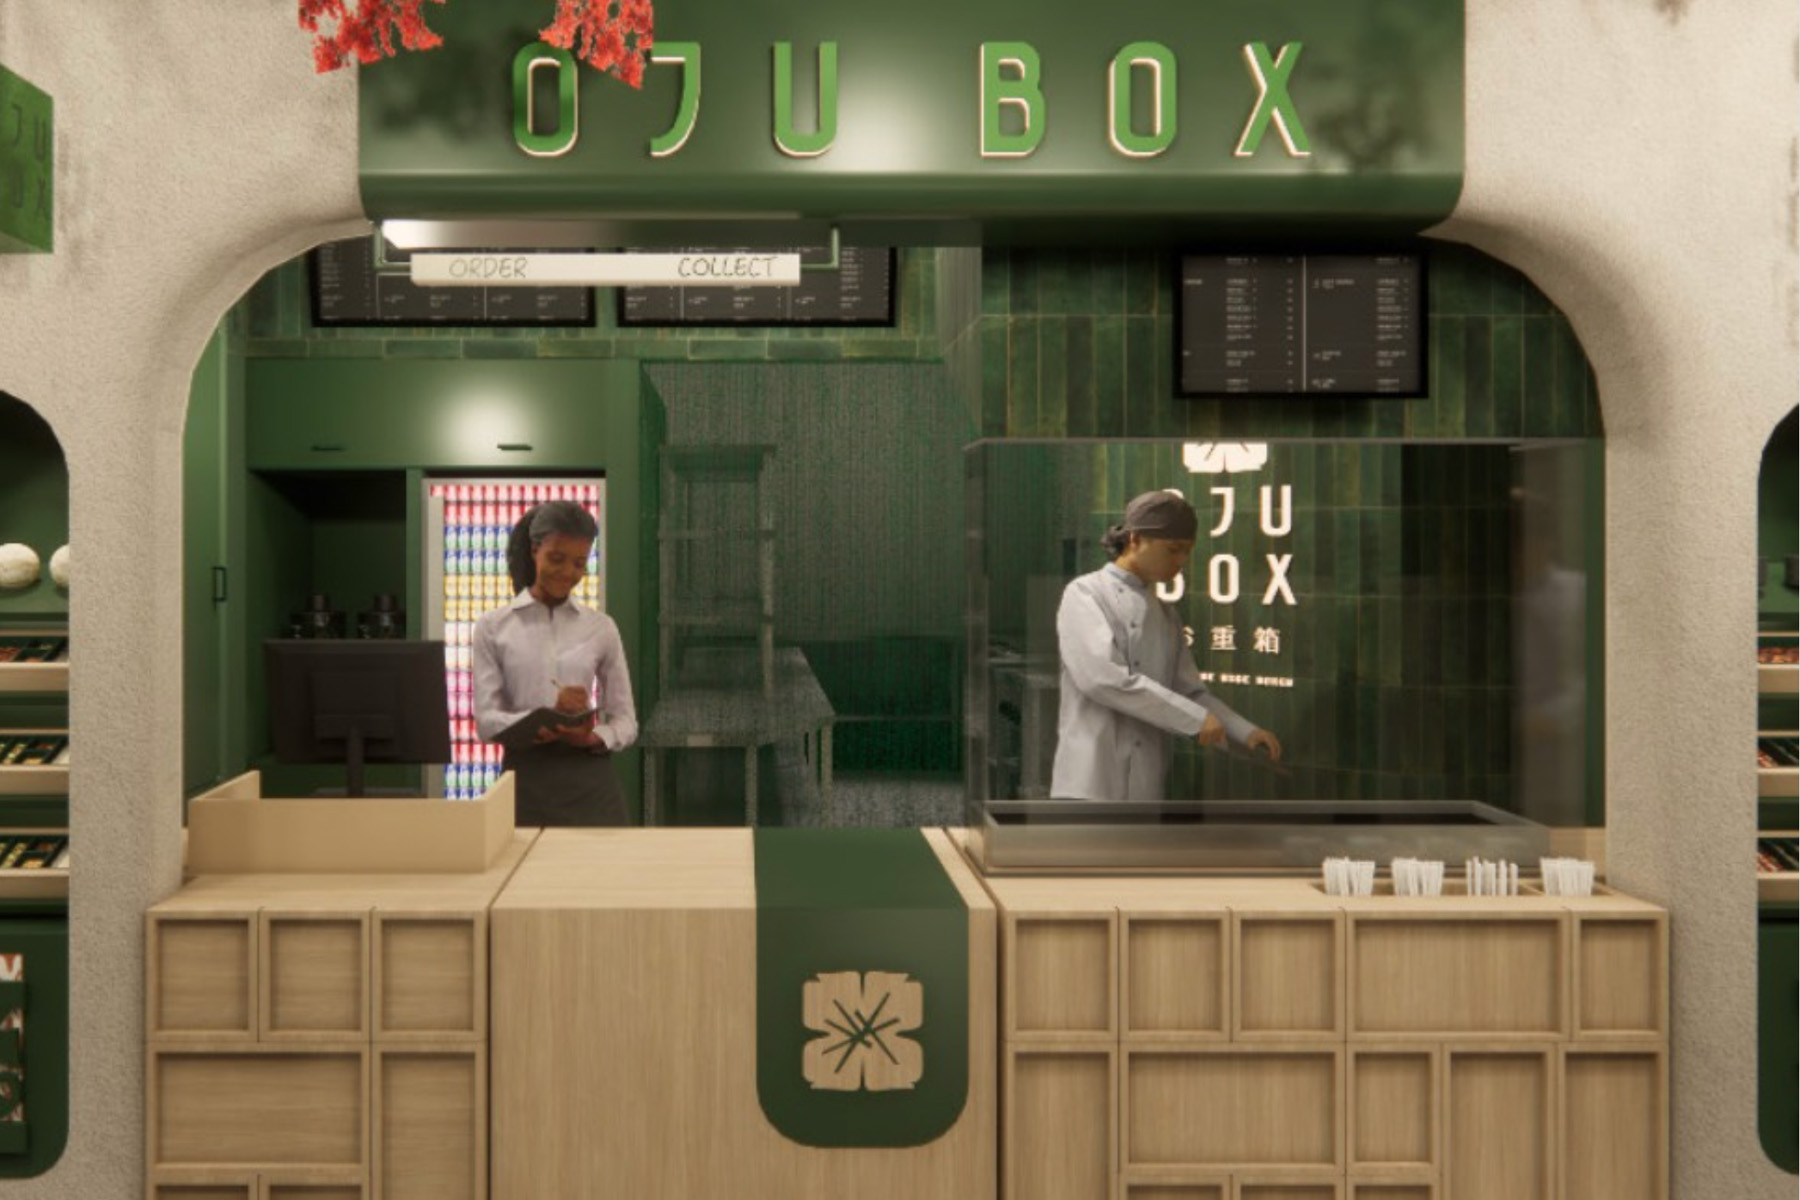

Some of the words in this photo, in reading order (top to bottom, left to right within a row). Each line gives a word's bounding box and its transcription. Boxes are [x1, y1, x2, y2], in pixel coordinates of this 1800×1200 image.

[513, 41, 838, 157] OJU
[980, 41, 1311, 157] BOX
[448, 256, 528, 278] ORDER
[678, 256, 778, 277] COLLECT
[1161, 485, 1292, 537] JU
